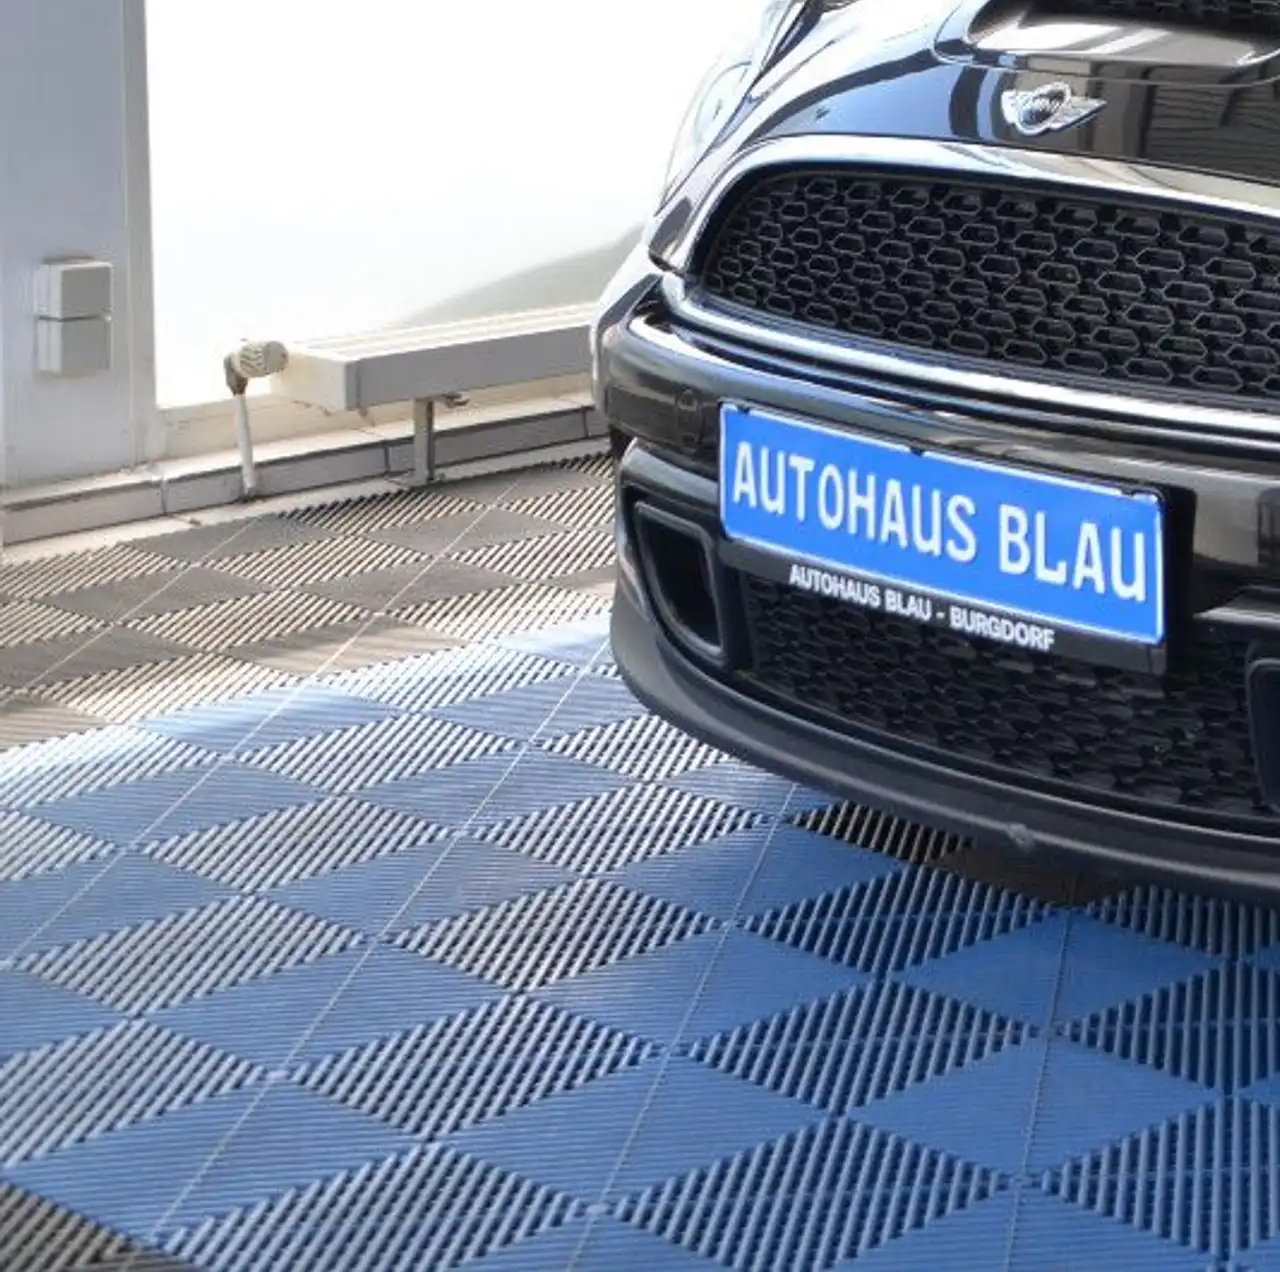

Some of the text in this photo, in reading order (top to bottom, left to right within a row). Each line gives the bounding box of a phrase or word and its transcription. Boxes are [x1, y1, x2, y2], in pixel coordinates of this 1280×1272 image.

[733, 440, 1146, 603] AUTOHAUS BLAU
[788, 564, 881, 608] AUTOHAUS
[884, 589, 932, 621] BLAU
[949, 604, 1055, 652] BURGDORF
